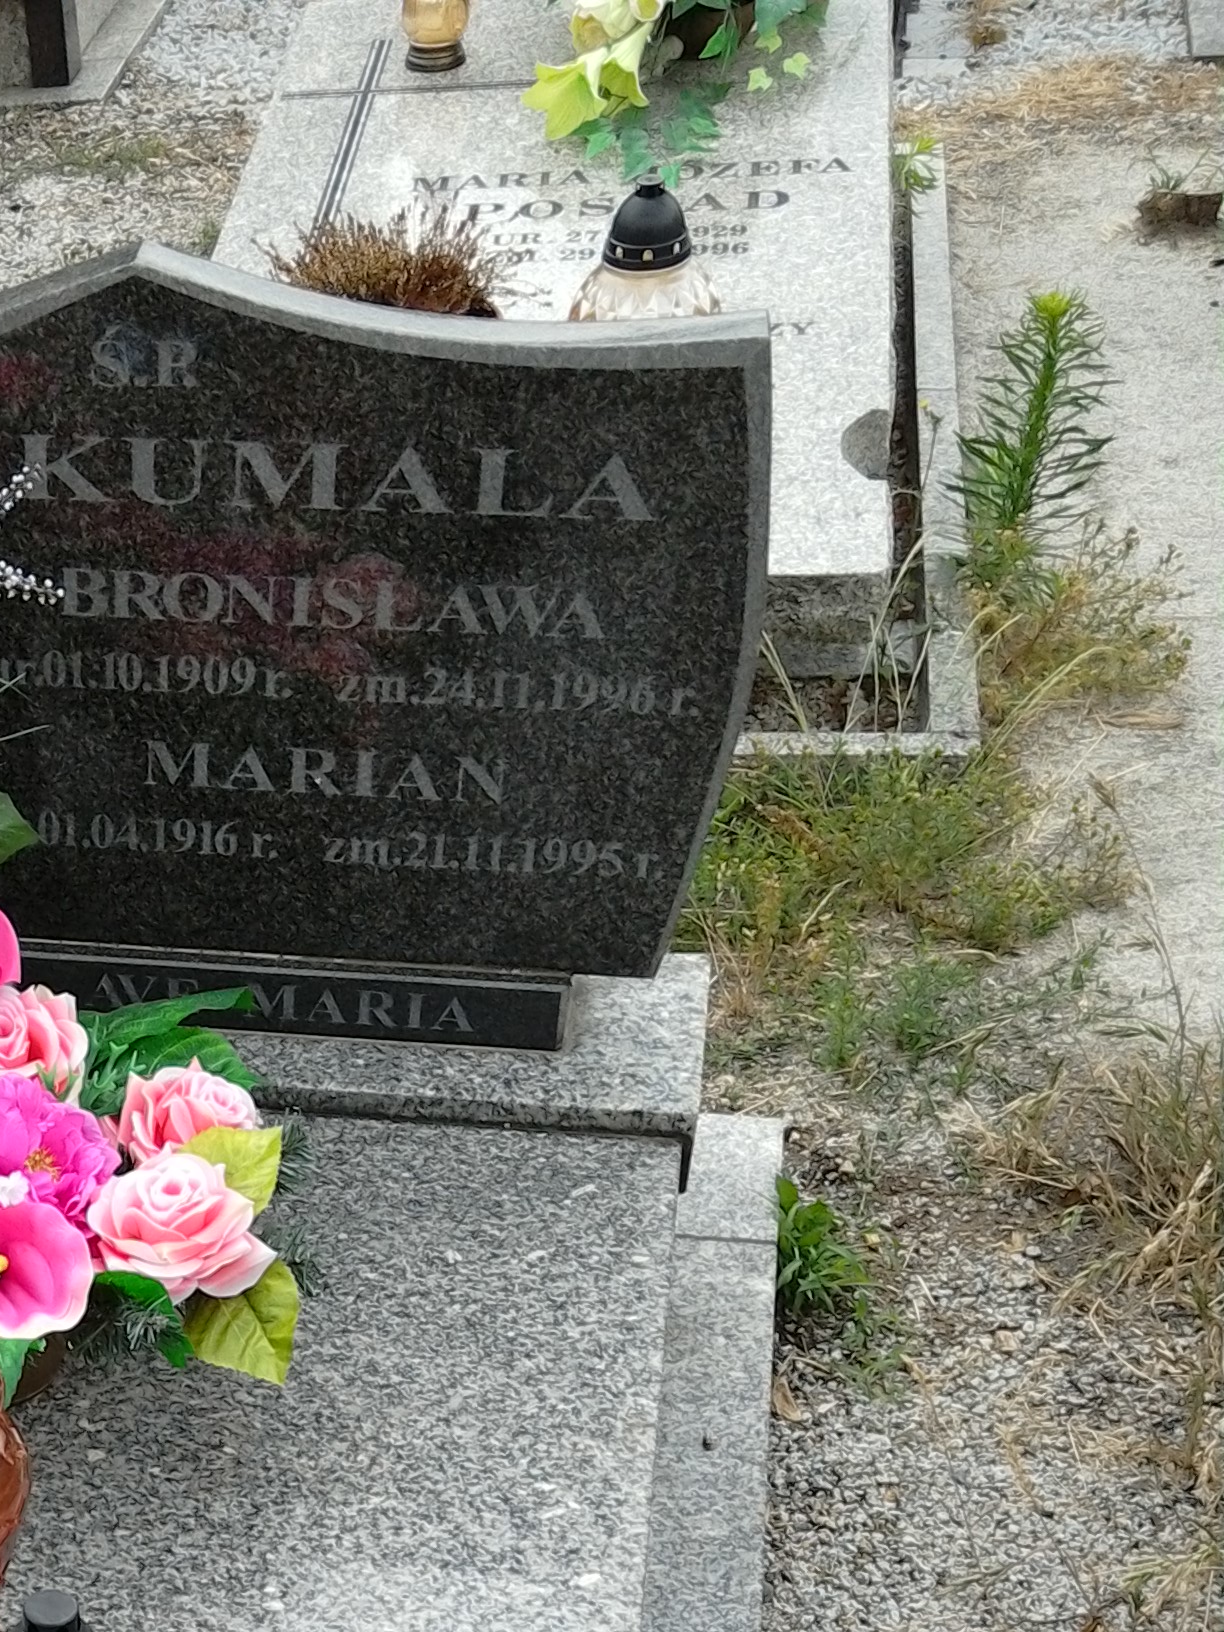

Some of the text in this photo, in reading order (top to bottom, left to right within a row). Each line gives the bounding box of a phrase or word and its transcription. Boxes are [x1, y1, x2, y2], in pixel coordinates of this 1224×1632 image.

[413, 156, 853, 193] MARIA ÓZEFA
[467, 189, 791, 221] POŚAD
[21, 432, 656, 522] KUMALA
[60, 566, 606, 640] BRONISŁAWA
[143, 738, 509, 806] MARIAN
[242, 982, 476, 1033] MARIA
